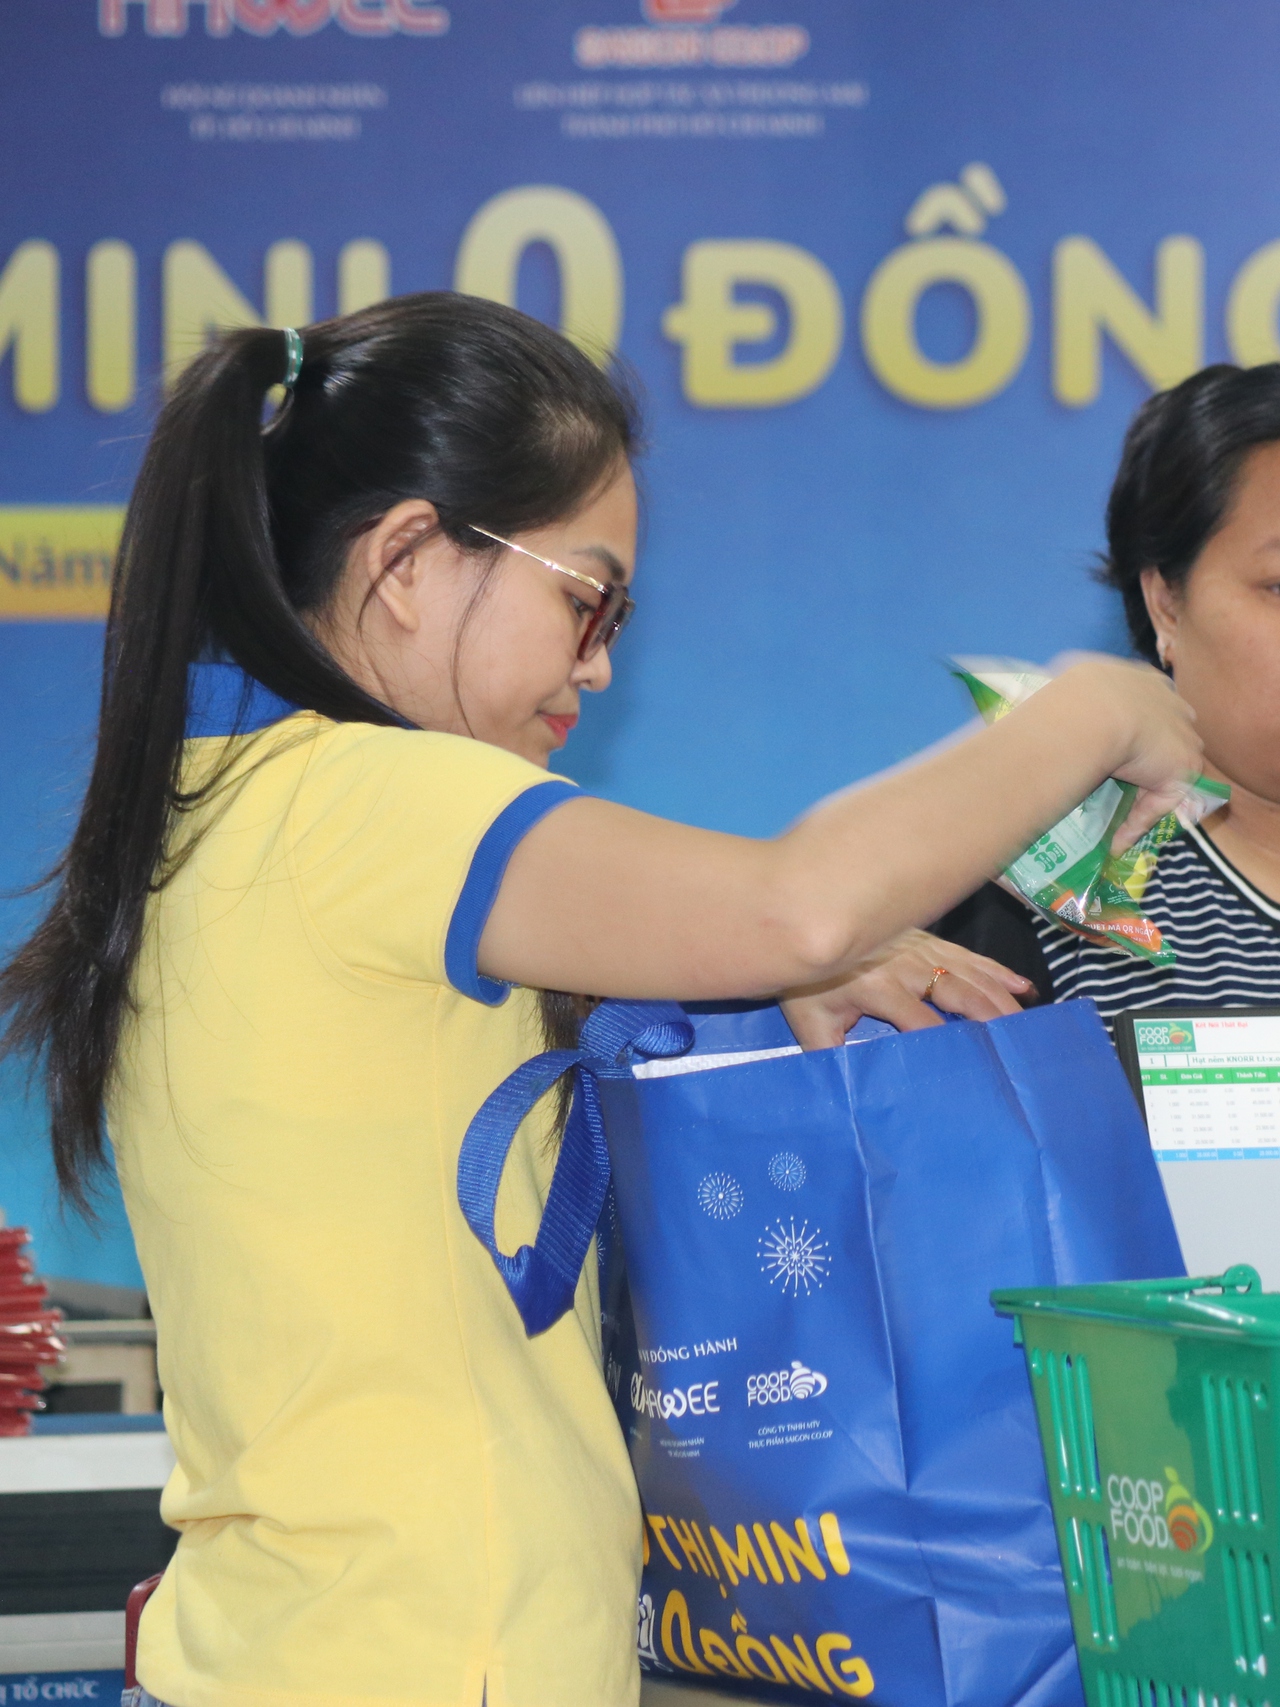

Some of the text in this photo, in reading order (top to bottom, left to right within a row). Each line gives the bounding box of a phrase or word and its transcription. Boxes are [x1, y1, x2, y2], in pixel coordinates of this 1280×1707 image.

[1122, 924, 1134, 935] QR
[1226, 1055, 1255, 1063] KNORR
[693, 1337, 738, 1359] HÀNH
[747, 1385, 791, 1408] FOOD
[1110, 1507, 1170, 1549] FOOD
[709, 1511, 851, 1587] MINI
[699, 1606, 876, 1698] ĐỒNG
